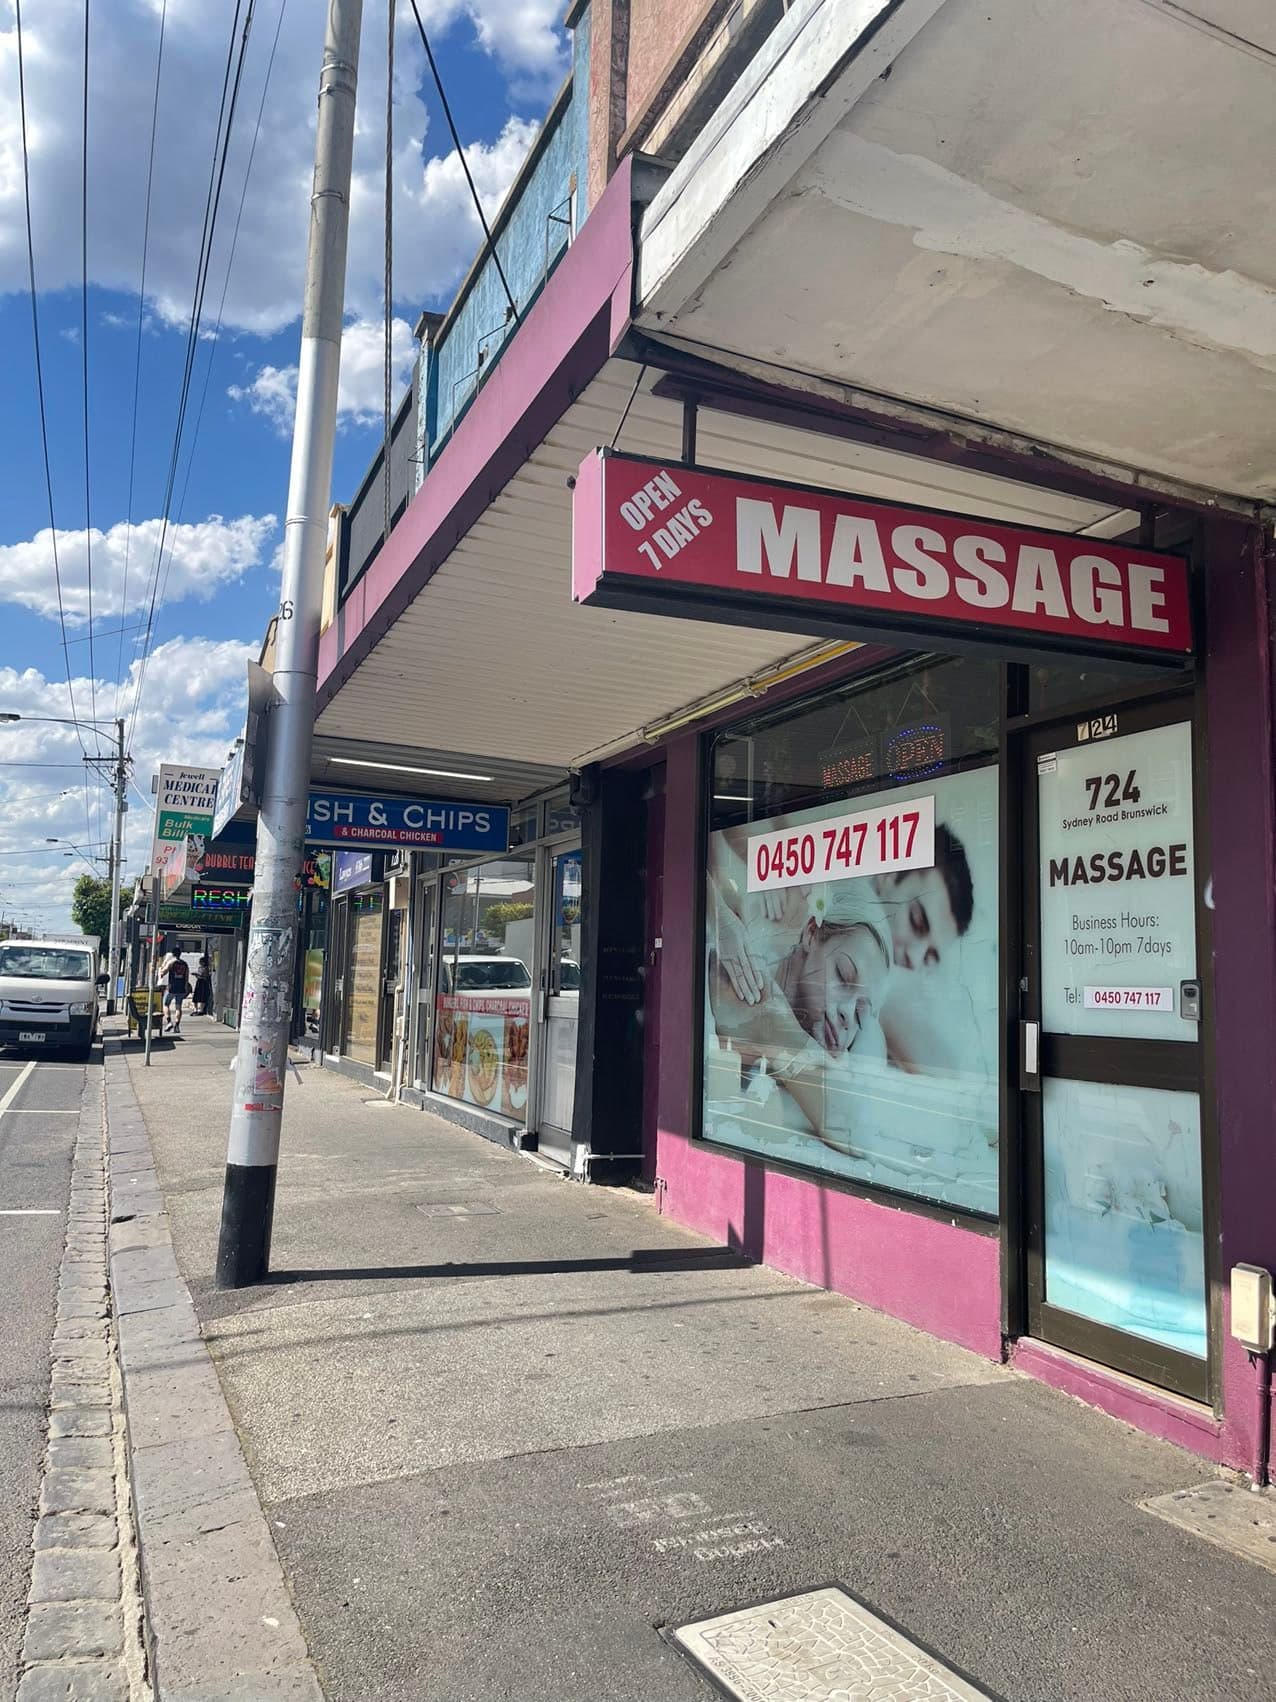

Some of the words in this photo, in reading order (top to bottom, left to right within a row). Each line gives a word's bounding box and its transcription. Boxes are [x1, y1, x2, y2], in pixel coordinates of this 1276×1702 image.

[620, 470, 682, 531] OPEN
[637, 541, 662, 571] 7
[652, 499, 713, 559] DAYS
[735, 496, 1170, 634] MASSAGE
[1078, 714, 1117, 740] 724
[164, 793, 214, 808] CENTRE
[1085, 769, 1140, 811] 724
[165, 818, 193, 830] Bulk
[306, 799, 354, 823] ISH
[368, 802, 388, 826] &
[403, 805, 491, 833] CHIPS
[1062, 817, 1093, 831] Sydney
[1096, 811, 1119, 825] Road
[1121, 803, 1168, 820] Brunswick
[341, 827, 348, 837] &
[351, 827, 397, 840] CHARCOAL
[400, 831, 437, 842] CHICKEN
[756, 834, 816, 882] 0450
[823, 823, 868, 871] 747
[877, 811, 920, 862] 117
[205, 852, 237, 869] BUBBLE
[1050, 843, 1188, 887] MASSAGE
[1072, 914, 1117, 931] Business
[1121, 912, 1160, 929] Hours:
[1064, 937, 1132, 958] 10am-10pm
[1136, 936, 1172, 957] 7days
[1064, 987, 1081, 1004] Tel:
[1094, 991, 1121, 1004] 0450
[1124, 991, 1142, 1005] 747
[1145, 992, 1161, 1005] 117
